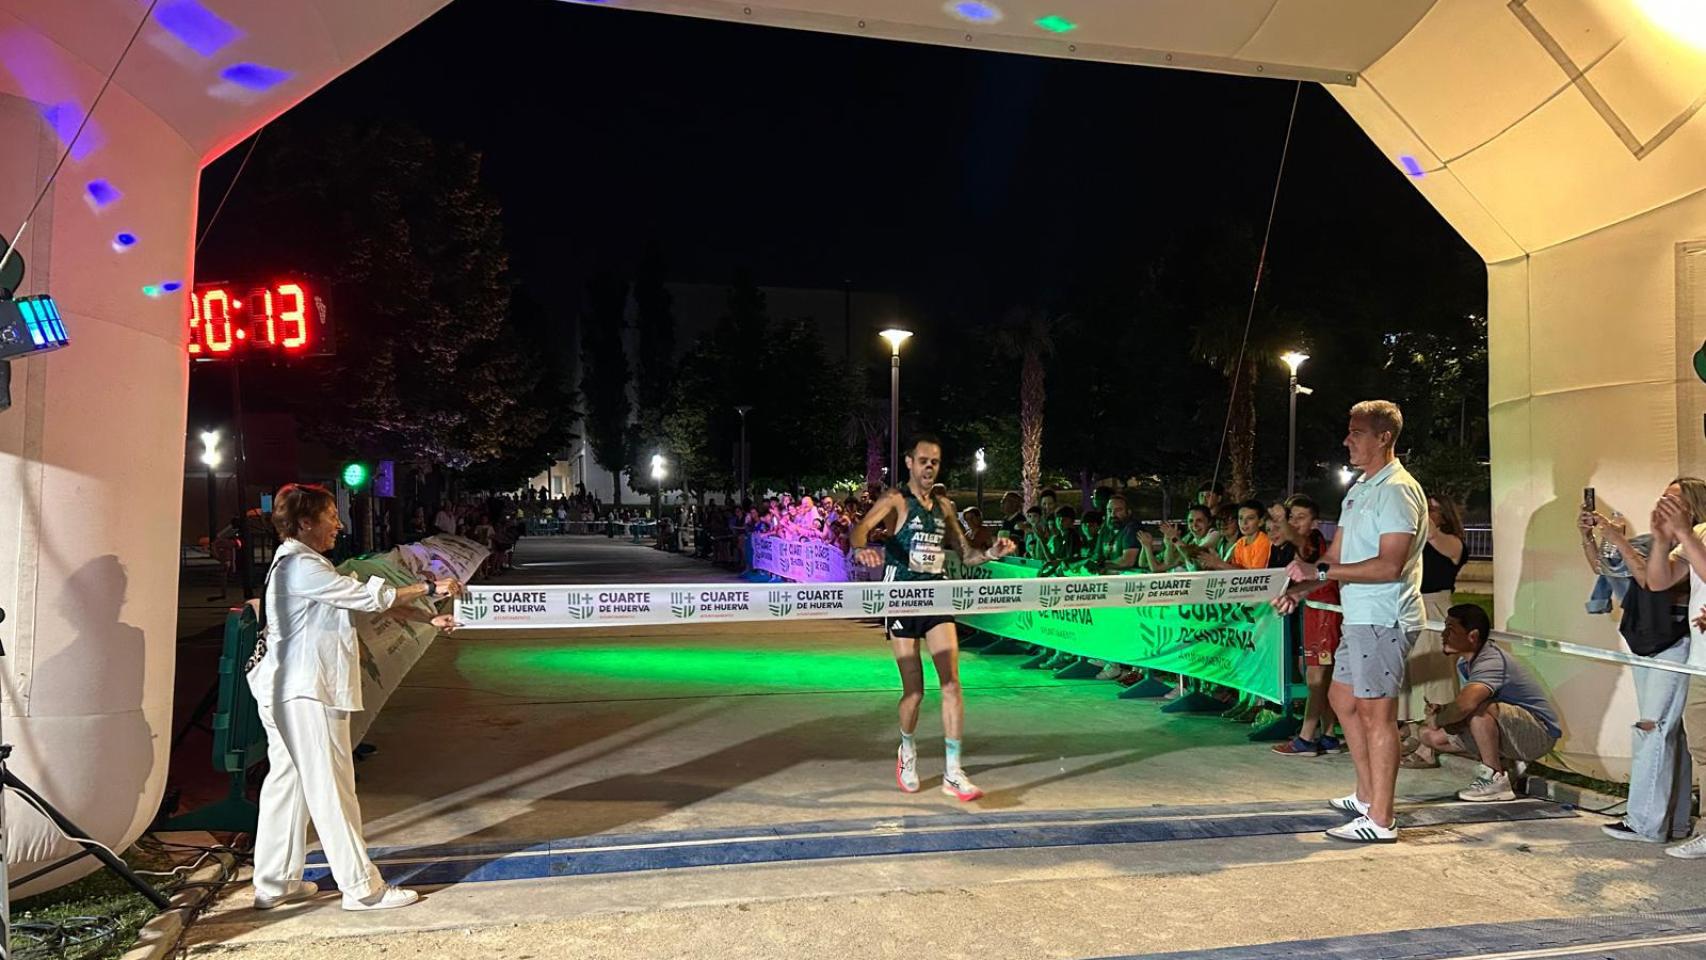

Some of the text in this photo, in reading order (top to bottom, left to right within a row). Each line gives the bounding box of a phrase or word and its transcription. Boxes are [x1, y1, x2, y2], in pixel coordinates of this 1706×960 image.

[922, 554, 936, 562] 245
[1150, 579, 1192, 590] CUARTE
[1231, 575, 1272, 585] CUARTE
[889, 588, 935, 598] CUARTE
[979, 585, 1023, 595] CUARTE
[1066, 583, 1109, 593] CUARTE
[1239, 585, 1269, 593] HUERVA
[493, 592, 546, 603] CUARTE
[599, 592, 651, 603] CUARTE
[701, 591, 750, 602] CUARTE
[797, 590, 844, 600] CUARTE
[990, 596, 1022, 604] HUERVA
[1076, 593, 1107, 601] HUERVA
[714, 603, 749, 611] HUERVA
[810, 601, 843, 609] HUERVA
[901, 599, 934, 607] HUERVA
[1051, 608, 1094, 626] HUERVA
